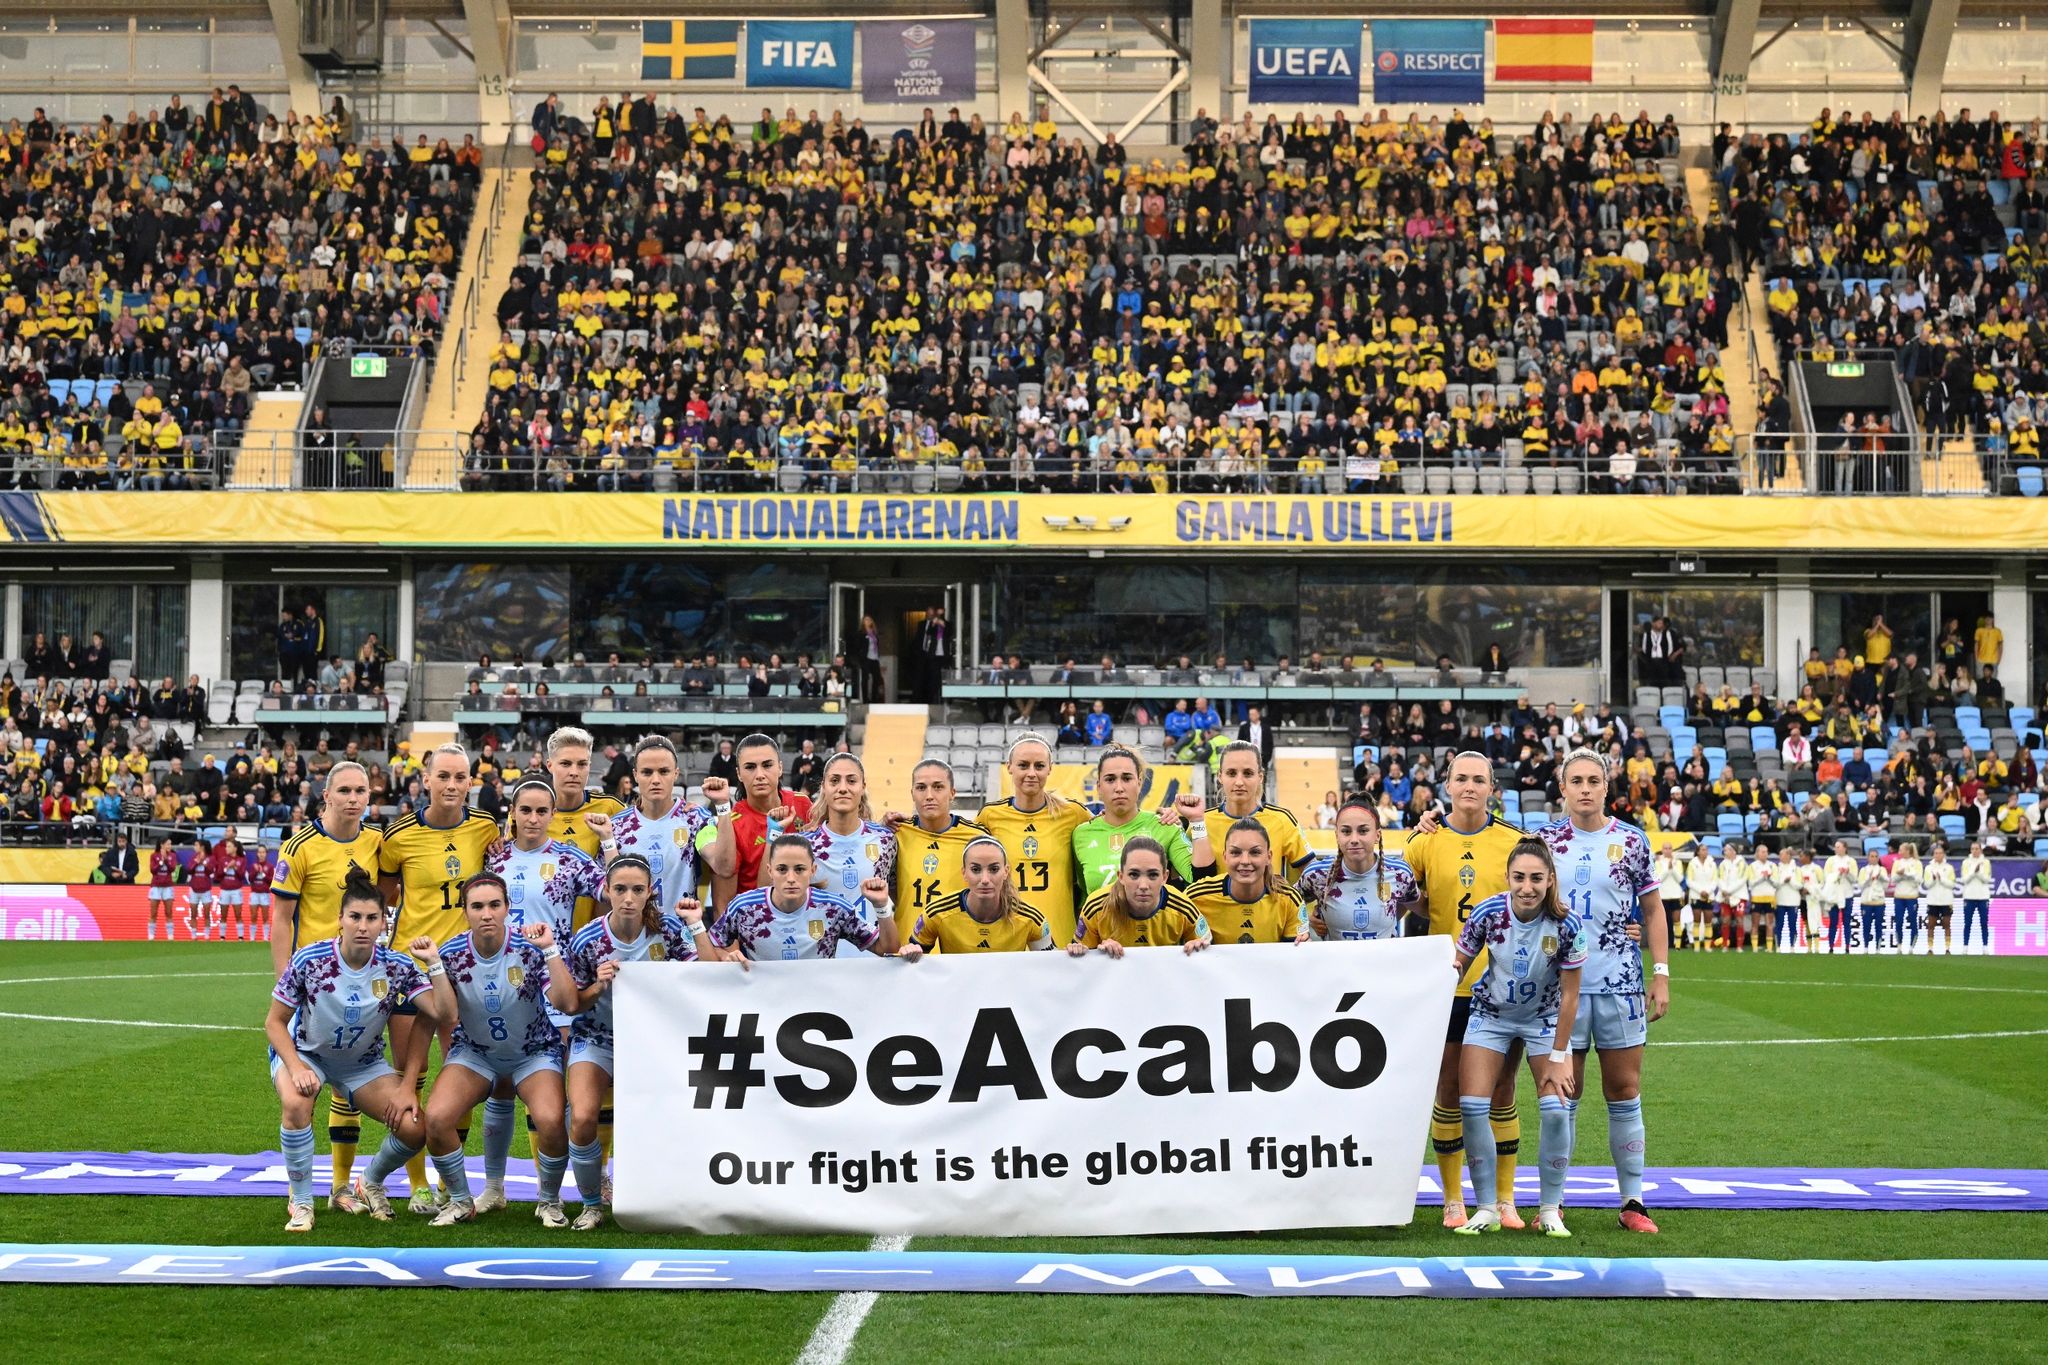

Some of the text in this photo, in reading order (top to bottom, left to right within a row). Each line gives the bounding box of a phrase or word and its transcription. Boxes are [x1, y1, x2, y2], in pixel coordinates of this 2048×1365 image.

[762, 40, 837, 68] FIFA
[1256, 47, 1351, 76] UEFA
[1403, 53, 1483, 71] RESPECT
[894, 76, 943, 87] NATIONS
[897, 86, 941, 97] LEAGUE
[663, 498, 1019, 541] NATIONALARENAN
[1175, 500, 1453, 542] GAMLA ULLEVI
[1680, 561, 1695, 572] M5
[1015, 862, 1049, 892] 13
[1457, 892, 1474, 923] 6
[1506, 979, 1537, 1005] 19
[331, 1025, 367, 1051] 17
[486, 1016, 509, 1042] 8
[687, 991, 1388, 1110] #SeAcabó
[709, 1134, 1373, 1193] Our fight is the global fight.
[0, 1252, 734, 1283] PEACE
[1014, 1263, 1585, 1290] МИР
